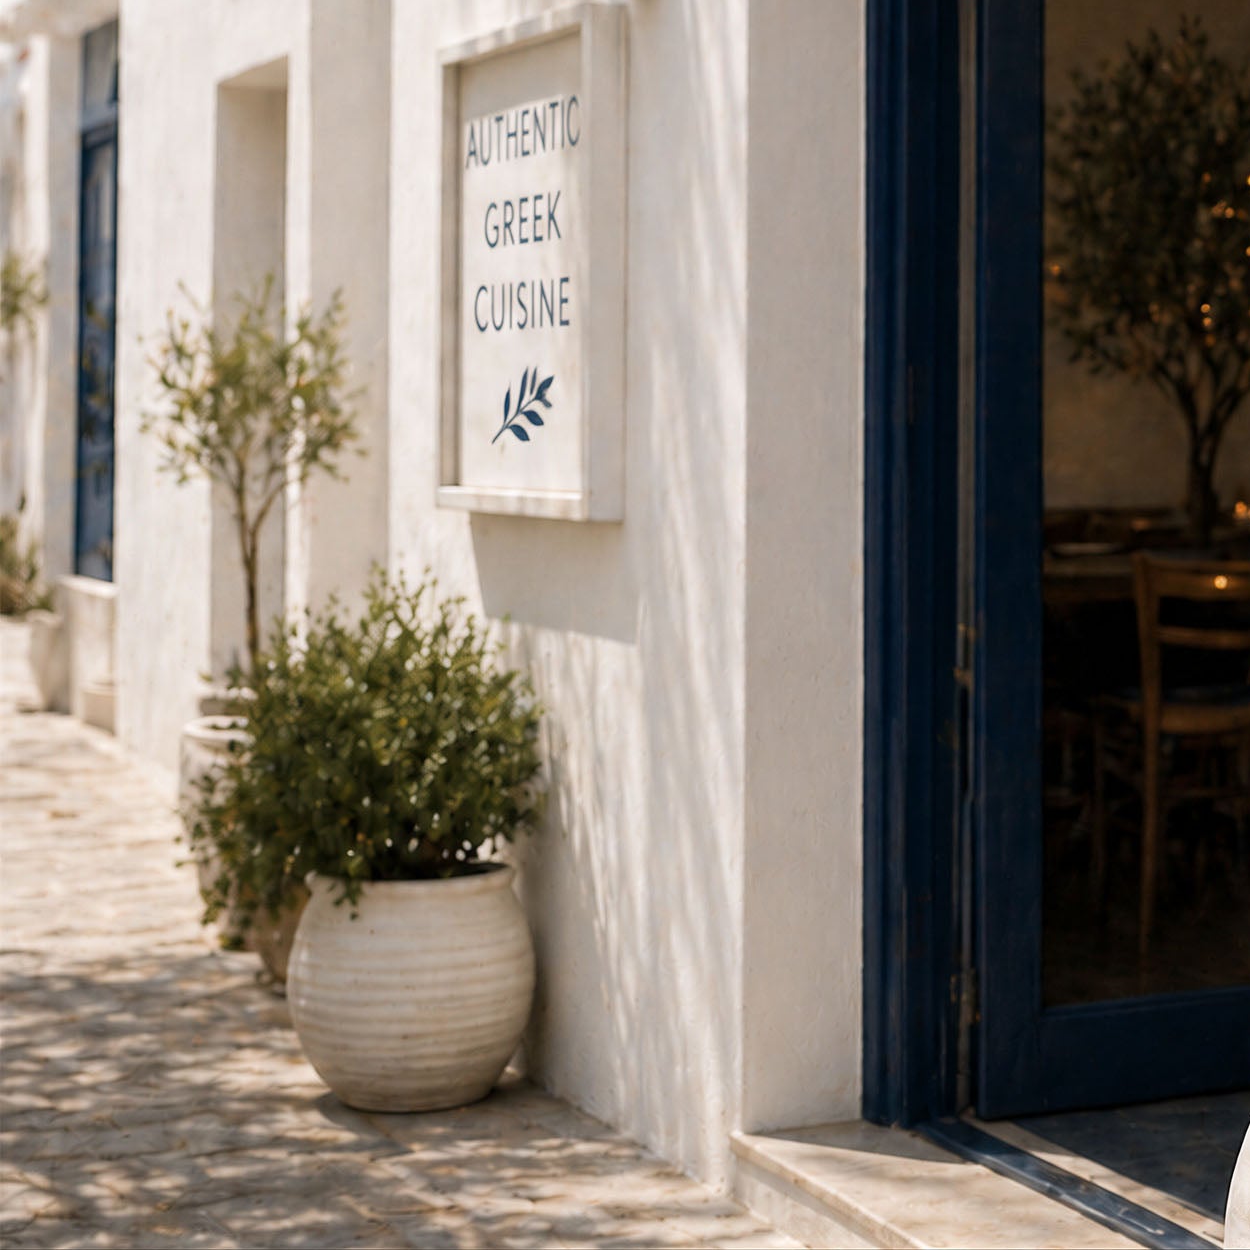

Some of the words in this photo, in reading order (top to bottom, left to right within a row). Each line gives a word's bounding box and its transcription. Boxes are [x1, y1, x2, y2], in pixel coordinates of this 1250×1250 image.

[465, 94, 581, 170] AUTHENTIC
[484, 190, 562, 248] GREEK
[473, 276, 571, 333] CUISINE
